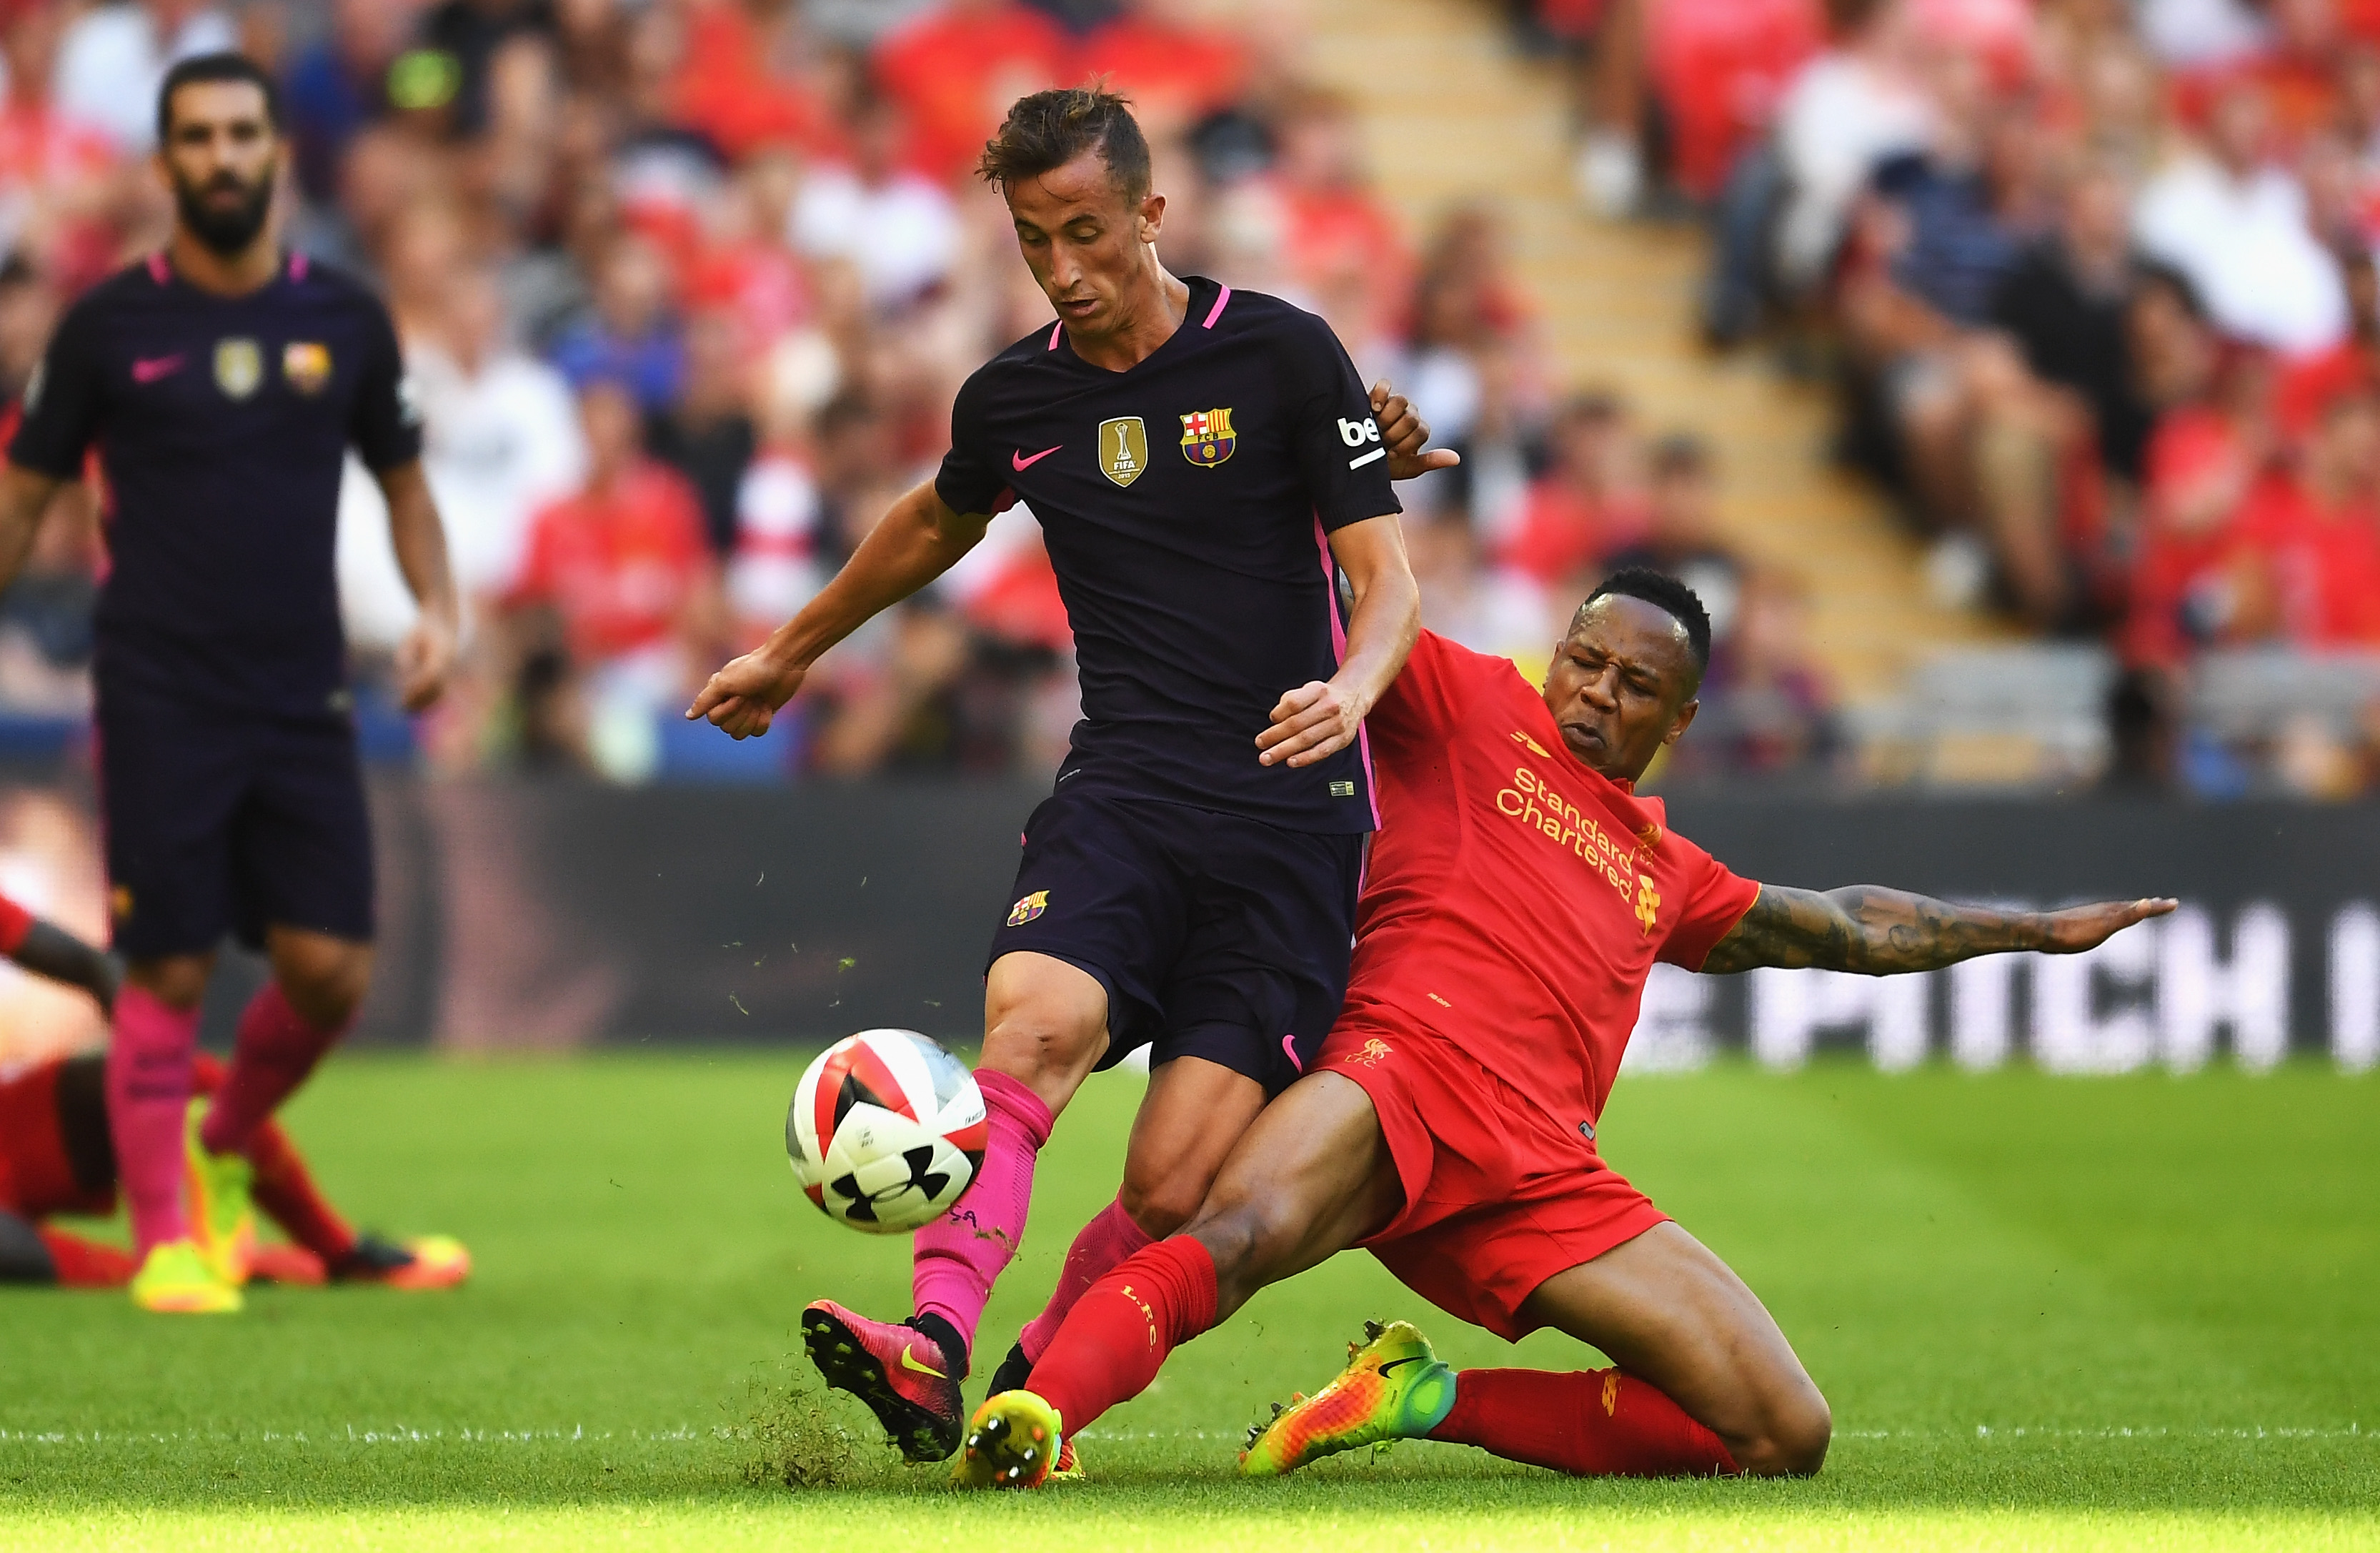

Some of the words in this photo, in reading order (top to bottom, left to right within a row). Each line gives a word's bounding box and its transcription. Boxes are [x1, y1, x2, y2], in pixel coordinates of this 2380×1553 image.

[1113, 460, 1135, 470] FIFA
[1198, 432, 1219, 443] FCB
[1496, 788, 1633, 903] Chartered
[1514, 767, 1635, 877] Standard
